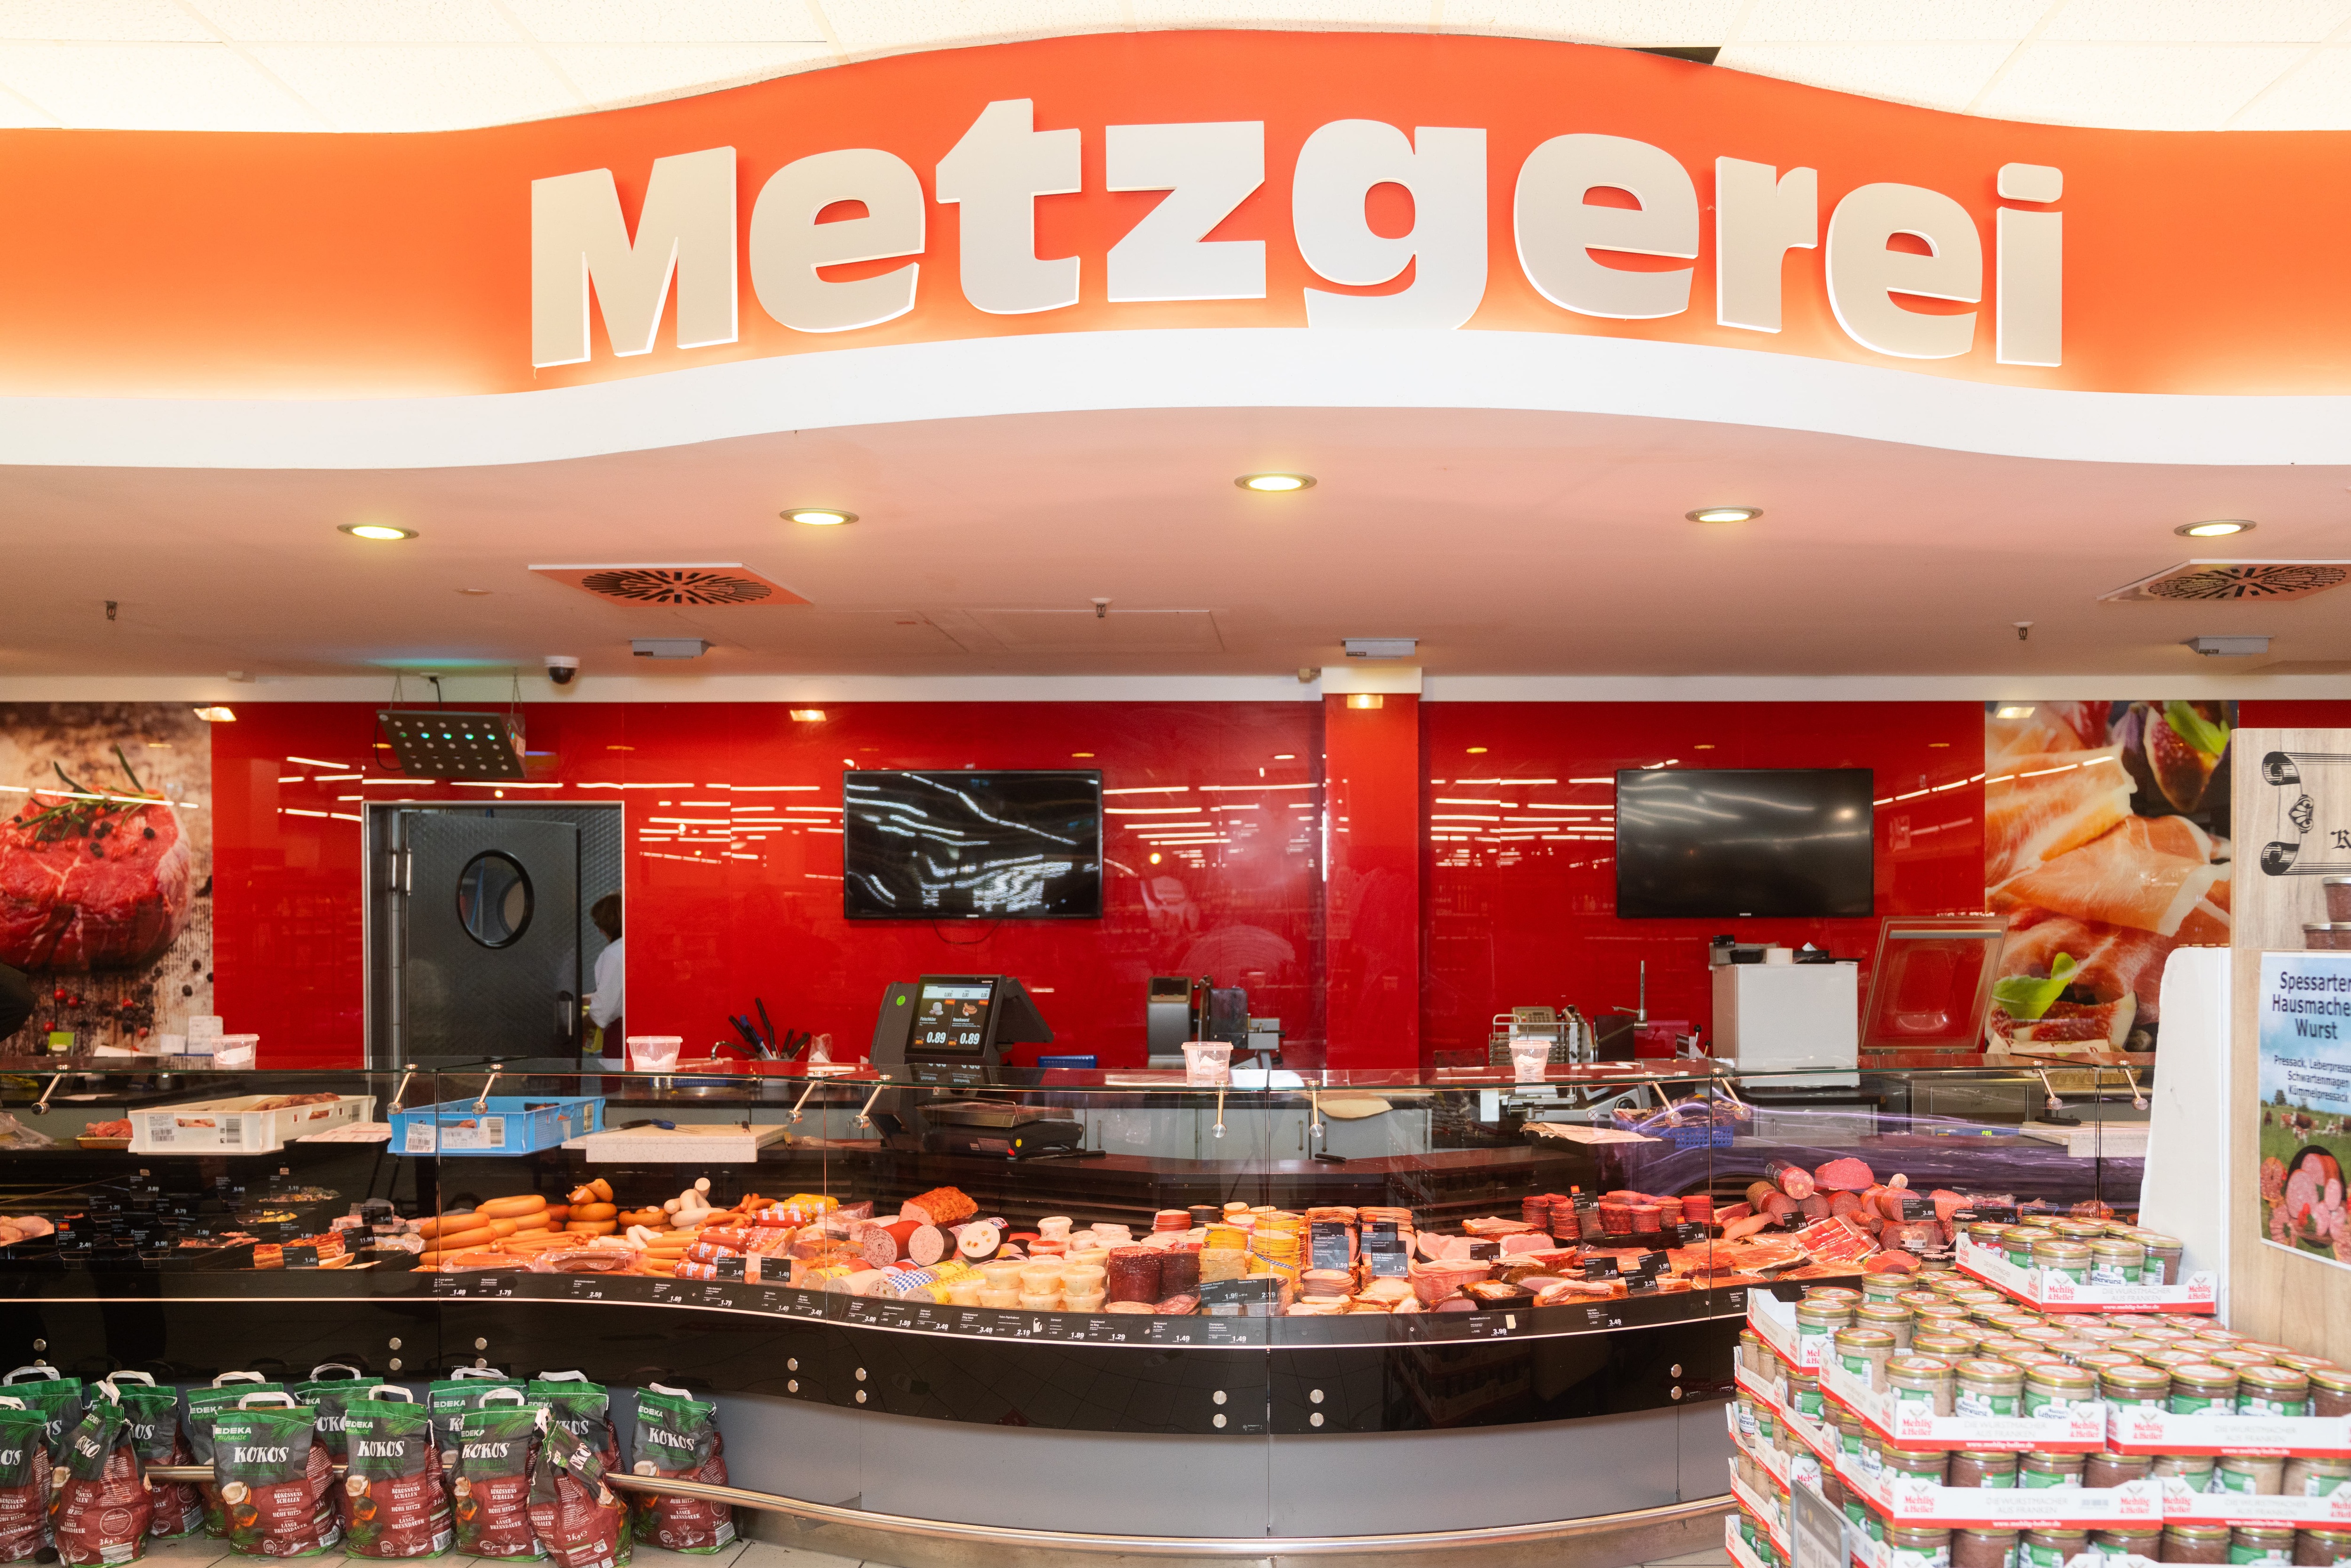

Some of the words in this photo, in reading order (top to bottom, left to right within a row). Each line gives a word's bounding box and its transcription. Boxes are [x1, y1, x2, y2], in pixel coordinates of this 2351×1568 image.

[530, 98, 2064, 370] Metzgerei
[2295, 1018, 2338, 1040] Wurst
[926, 1032, 947, 1044] 0.89
[960, 1032, 980, 1045] 0.89
[2288, 1071, 2350, 1089] Schwartenmagen
[2288, 1084, 2349, 1103] Kümmelpressack
[2048, 1285, 2075, 1295] Mehlig
[190, 1405, 223, 1414] EDEKA
[434, 1400, 466, 1408] EDEKA
[638, 1405, 663, 1418] EDEKA
[1902, 1418, 1933, 1429] Mehlig
[2071, 1421, 2100, 1431] Mehlig
[2134, 1422, 2164, 1432] Mehlig
[461, 1429, 485, 1437] EDEKA
[648, 1427, 694, 1451] KOKOS
[357, 1441, 405, 1457] KOKOS
[462, 1442, 511, 1458] KOKOS
[234, 1447, 289, 1463] KOKOS
[1904, 1496, 1934, 1506] Mehlig
[2120, 1497, 2150, 1507] Mehlig
[274, 1523, 308, 1534] BRENNDAUER
[392, 1518, 425, 1529] BRENNDAUER
[489, 1521, 522, 1530] BRENNDAUER
